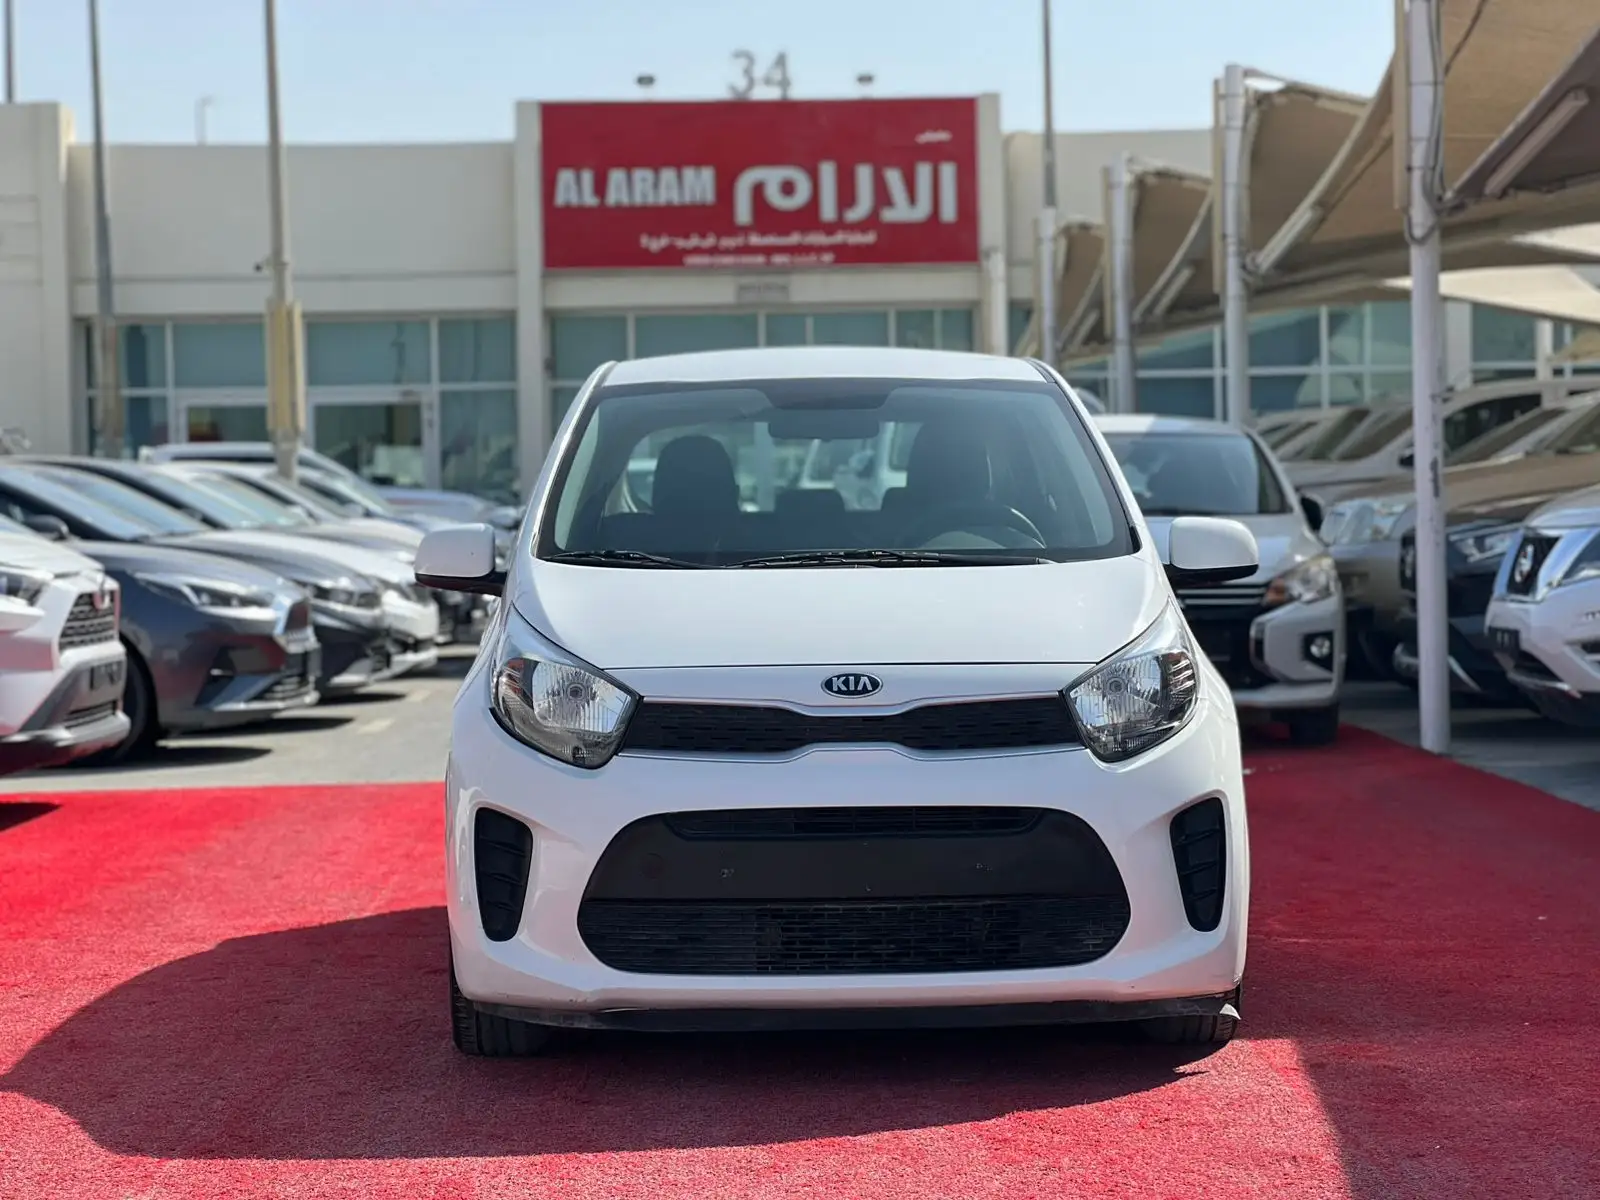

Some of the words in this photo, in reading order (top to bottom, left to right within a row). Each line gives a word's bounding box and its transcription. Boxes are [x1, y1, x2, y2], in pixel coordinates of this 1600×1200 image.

[728, 49, 792, 100] 34
[554, 167, 601, 207] AL
[604, 165, 717, 206] ARAM
[831, 676, 873, 691] KIA
